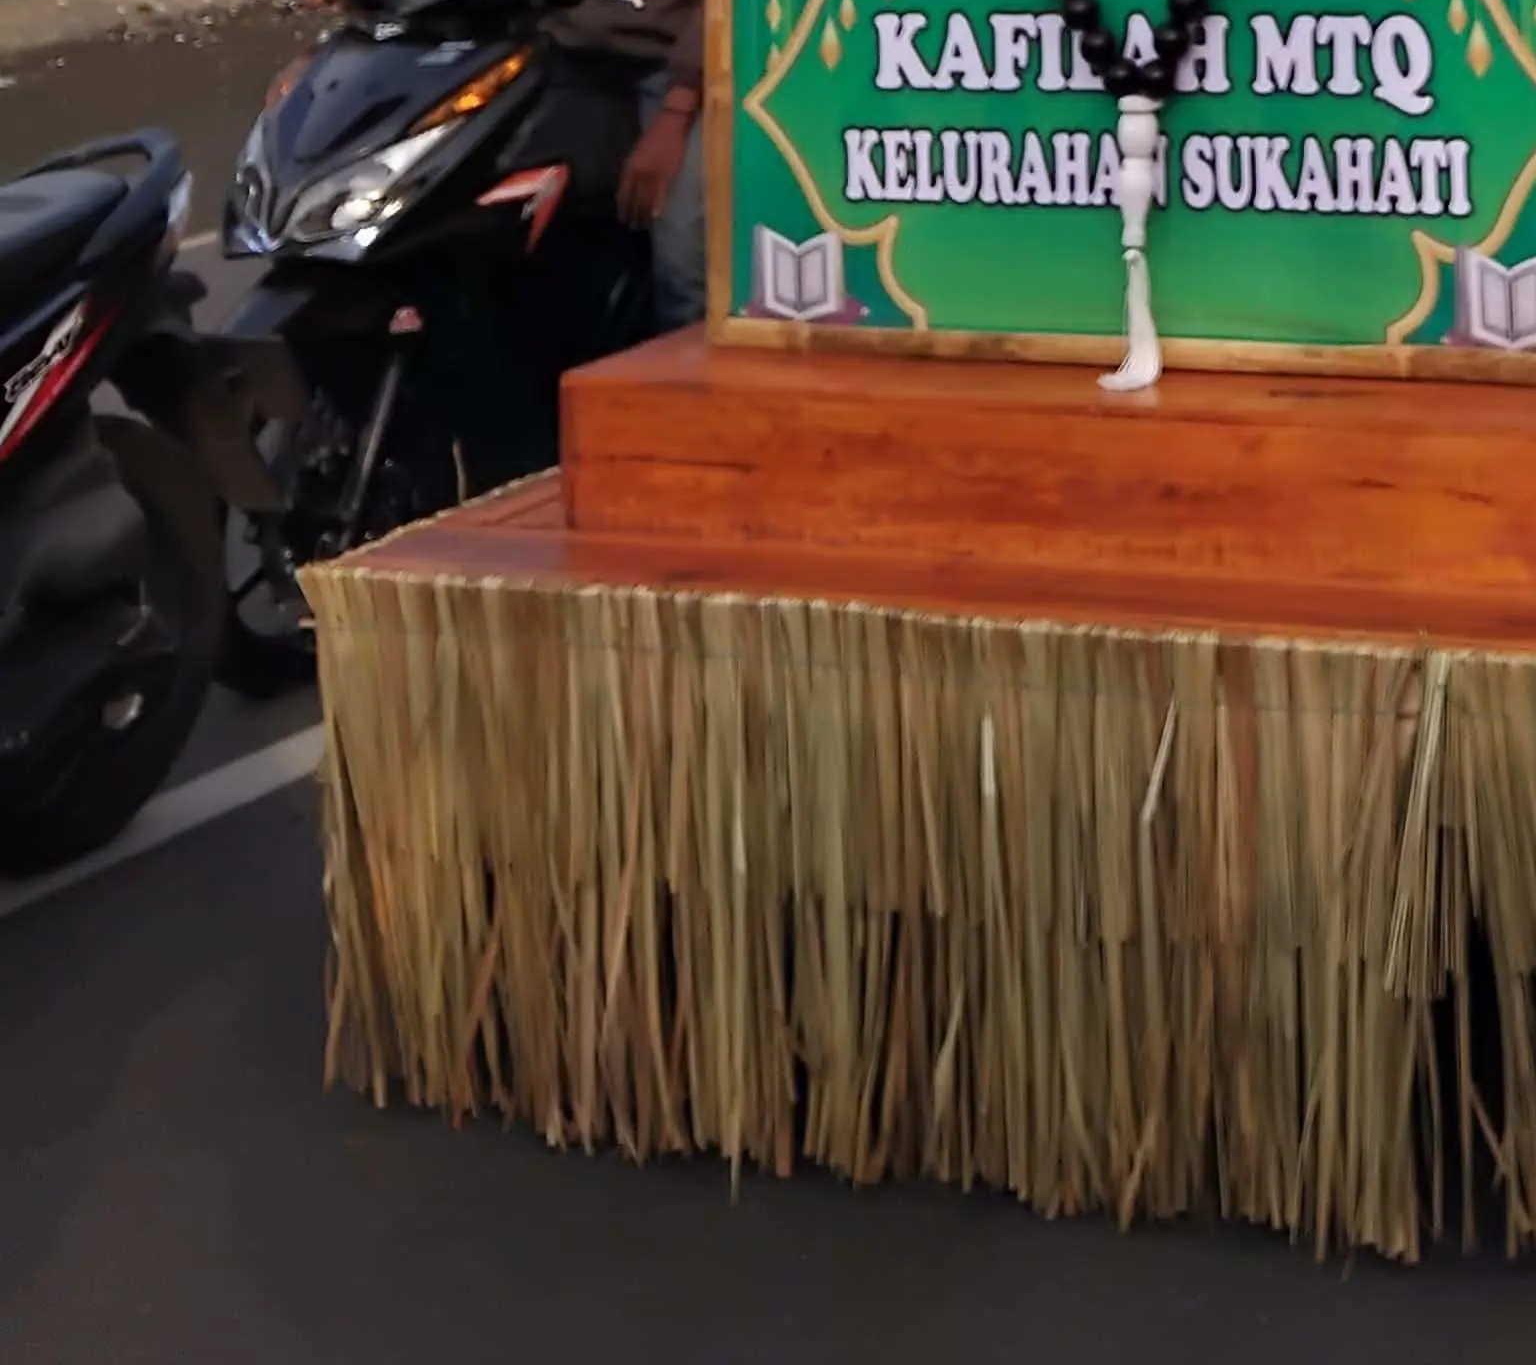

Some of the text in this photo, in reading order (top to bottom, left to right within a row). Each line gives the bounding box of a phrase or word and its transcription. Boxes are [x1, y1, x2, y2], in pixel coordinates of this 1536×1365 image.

[873, 11, 1435, 115] KAFILAH MTQ
[1182, 133, 1472, 215] SUKAHATI
